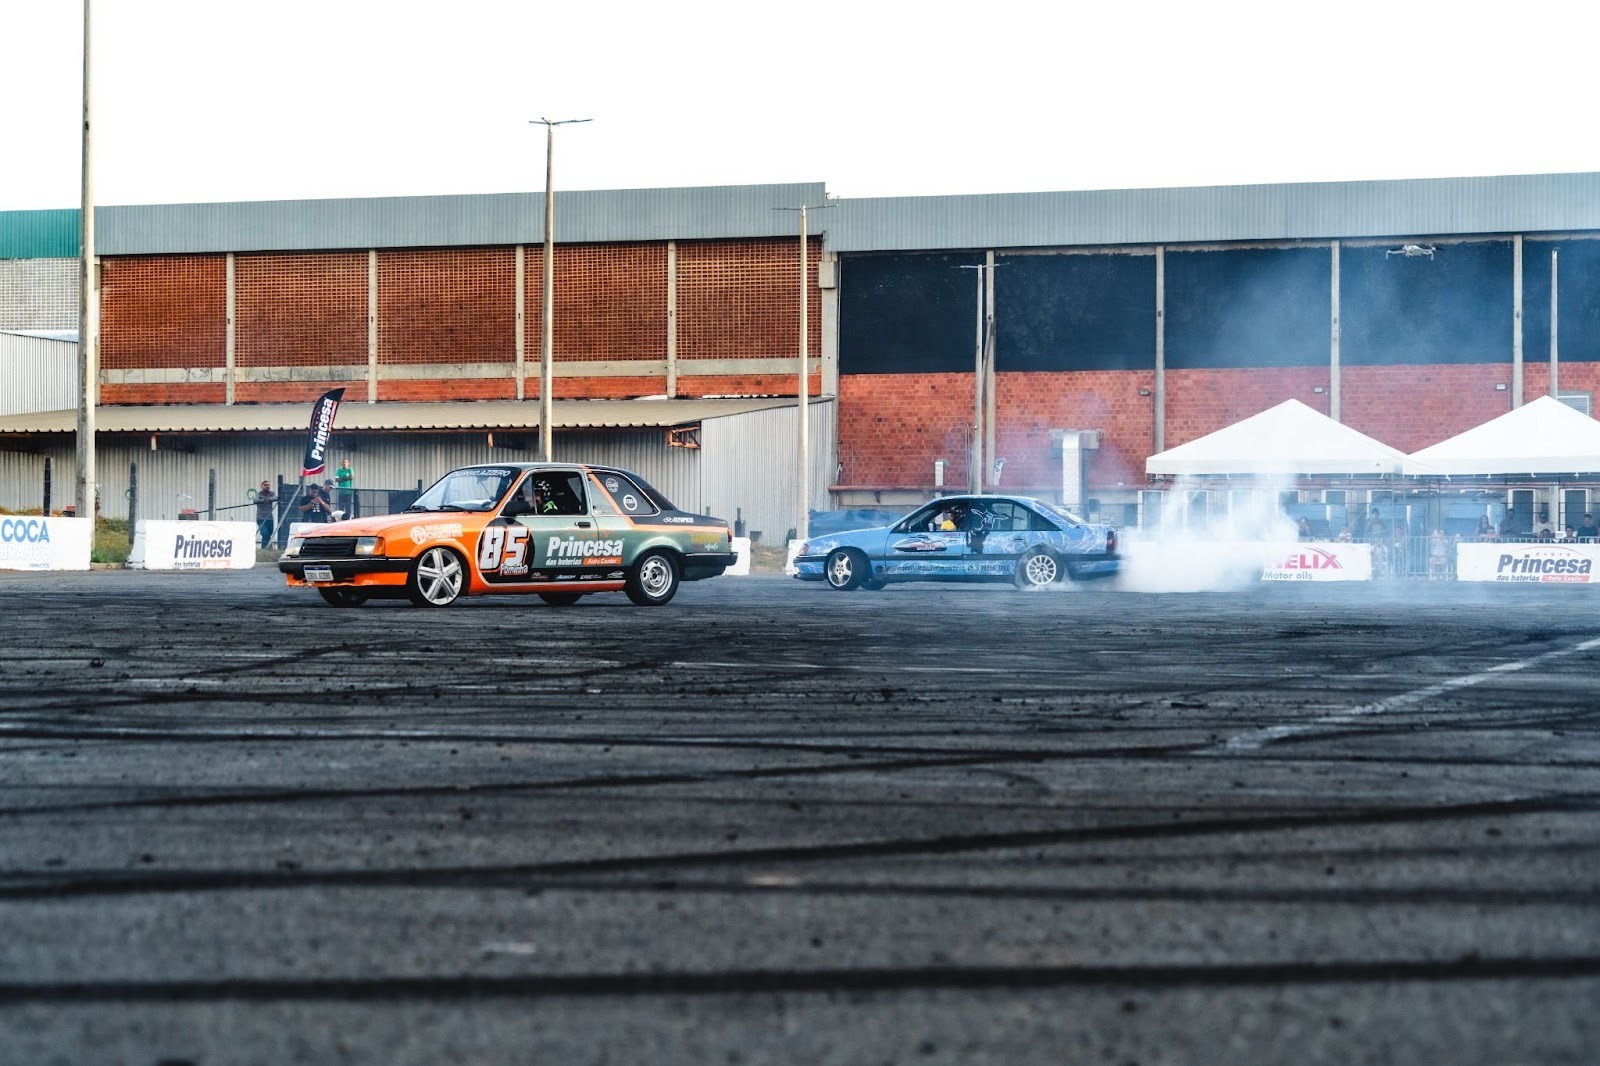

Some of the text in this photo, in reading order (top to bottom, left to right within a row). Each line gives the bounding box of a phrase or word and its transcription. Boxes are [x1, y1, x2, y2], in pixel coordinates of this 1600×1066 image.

[311, 398, 333, 461] Princesa
[1, 519, 50, 543] COCA
[174, 534, 232, 558] Princesa
[479, 526, 529, 573] 85
[546, 536, 624, 557] Princesa
[545, 557, 582, 566] das baterias
[1496, 553, 1592, 574] Princesa
[1264, 571, 1313, 580] Motor oils
[1510, 574, 1540, 582] baterias
